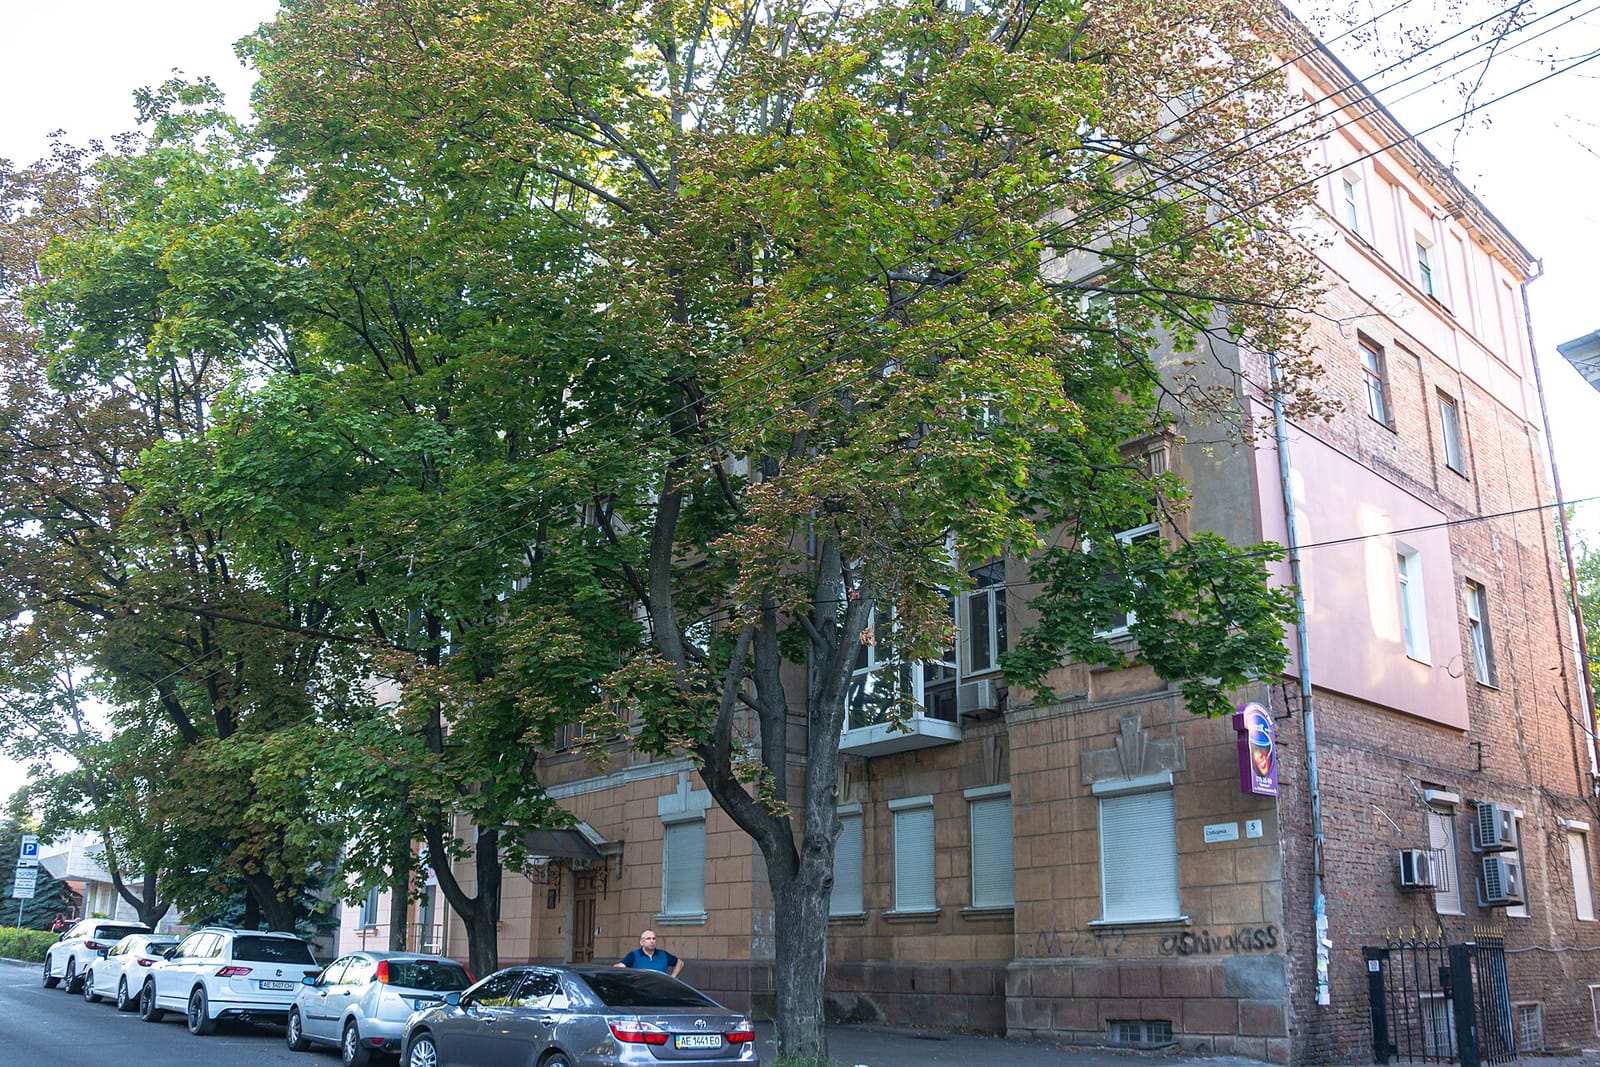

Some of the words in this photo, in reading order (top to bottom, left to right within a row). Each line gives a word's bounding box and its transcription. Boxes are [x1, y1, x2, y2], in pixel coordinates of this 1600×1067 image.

[1251, 822, 1256, 831] 5
[26, 844, 35, 854] P
[681, 1036, 691, 1046] AE
[693, 1036, 708, 1046] 1441
